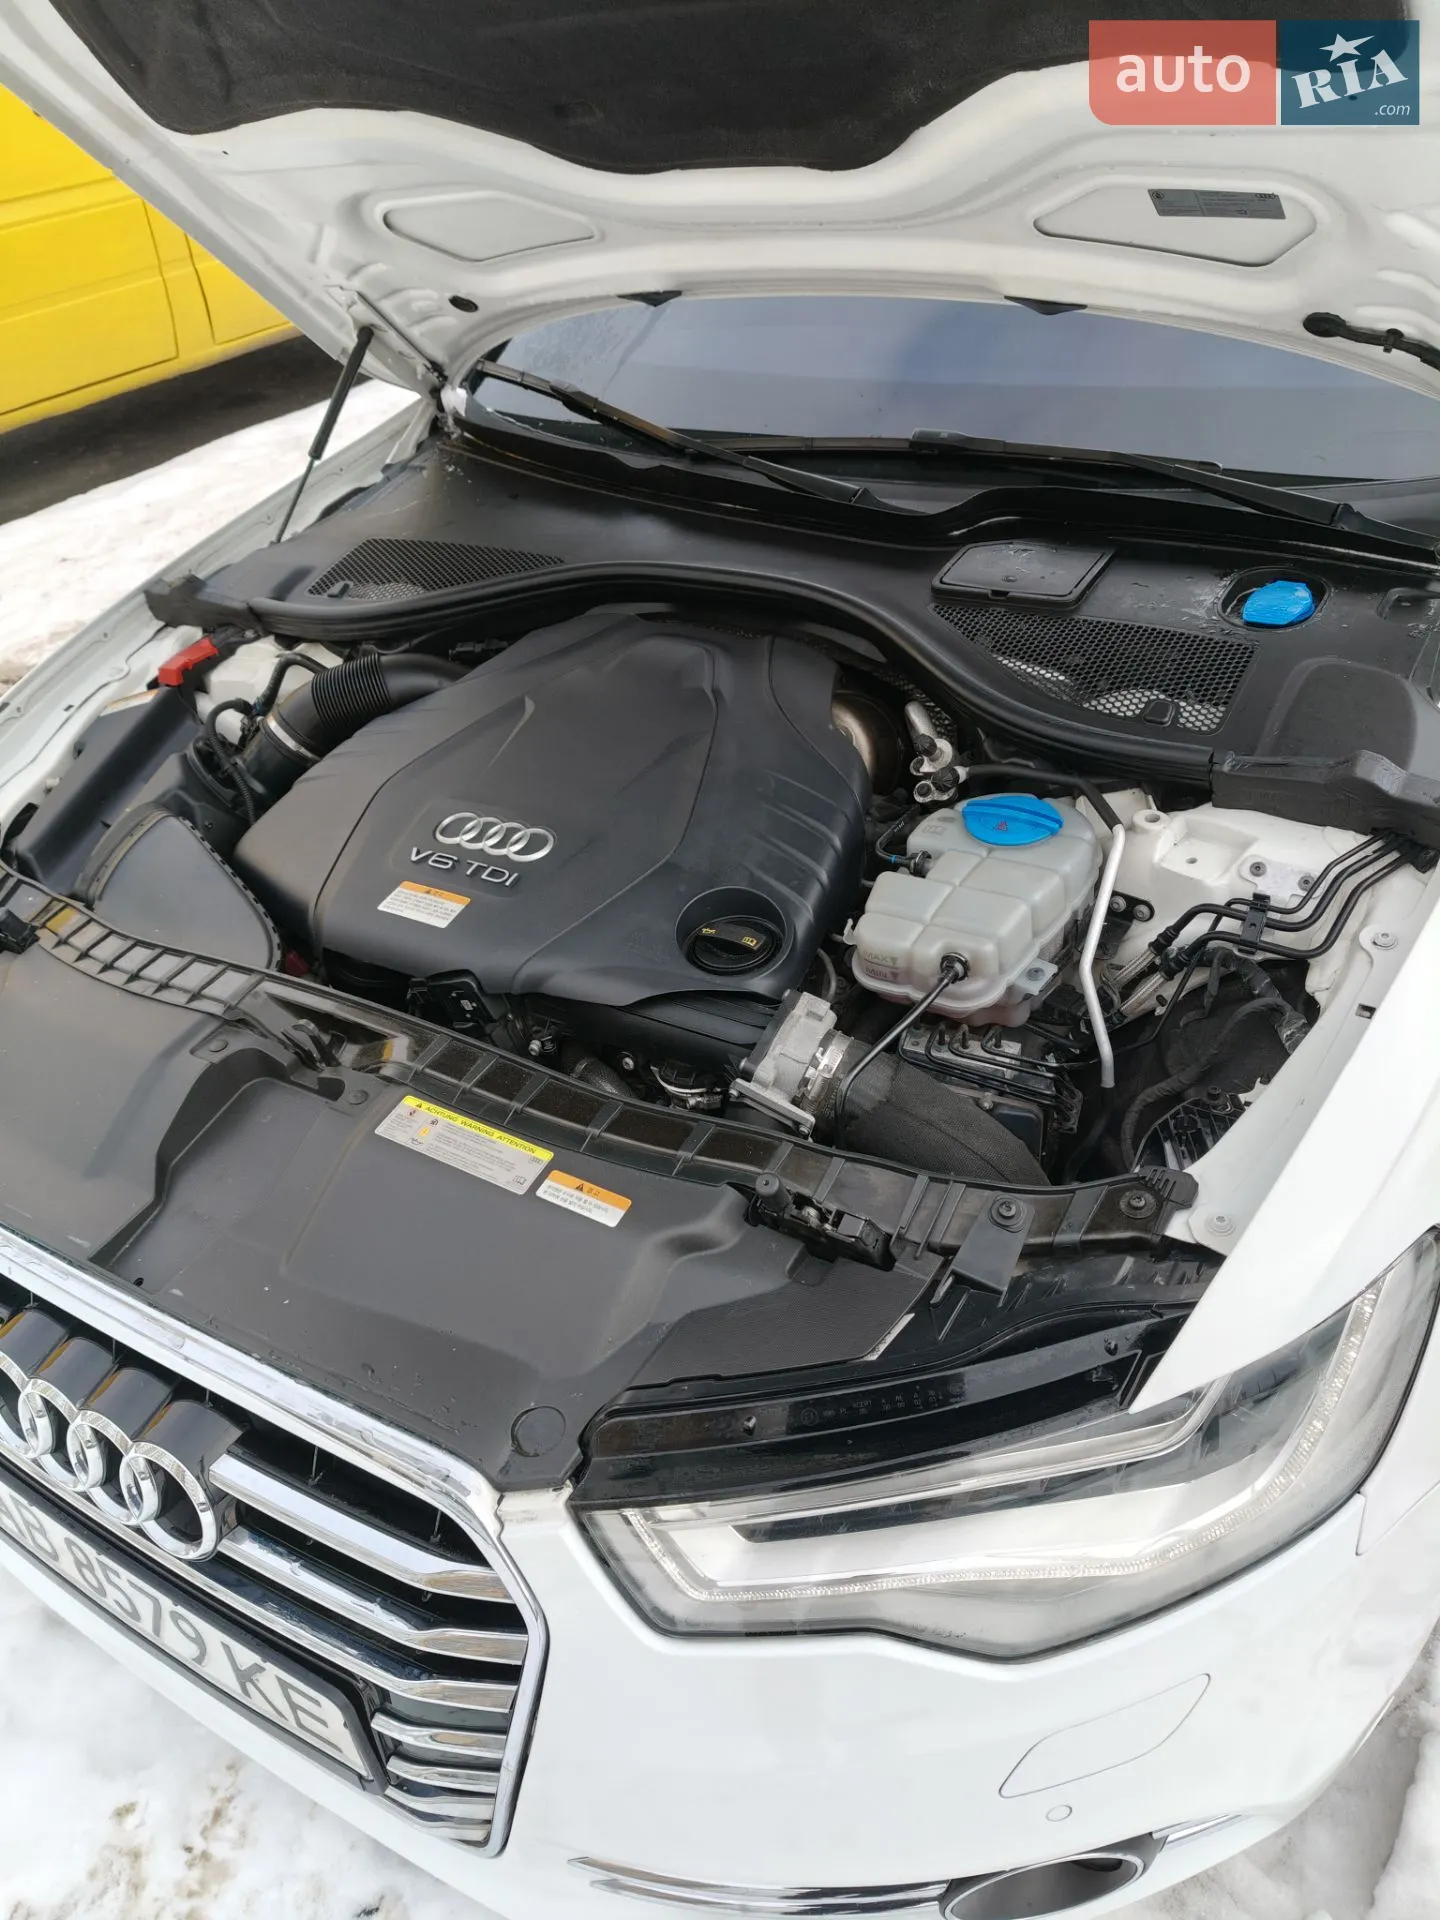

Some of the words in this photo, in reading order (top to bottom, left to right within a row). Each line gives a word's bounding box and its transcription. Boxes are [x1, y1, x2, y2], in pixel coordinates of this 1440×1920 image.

[410, 847, 459, 870] V6
[465, 860, 519, 887] TDI
[425, 1106, 458, 1123] ACHTUNG
[460, 1119, 495, 1138] WARNING
[495, 1134, 537, 1154] ATTENTION
[63, 1536, 208, 1667] 8579
[220, 1641, 344, 1754] KE
